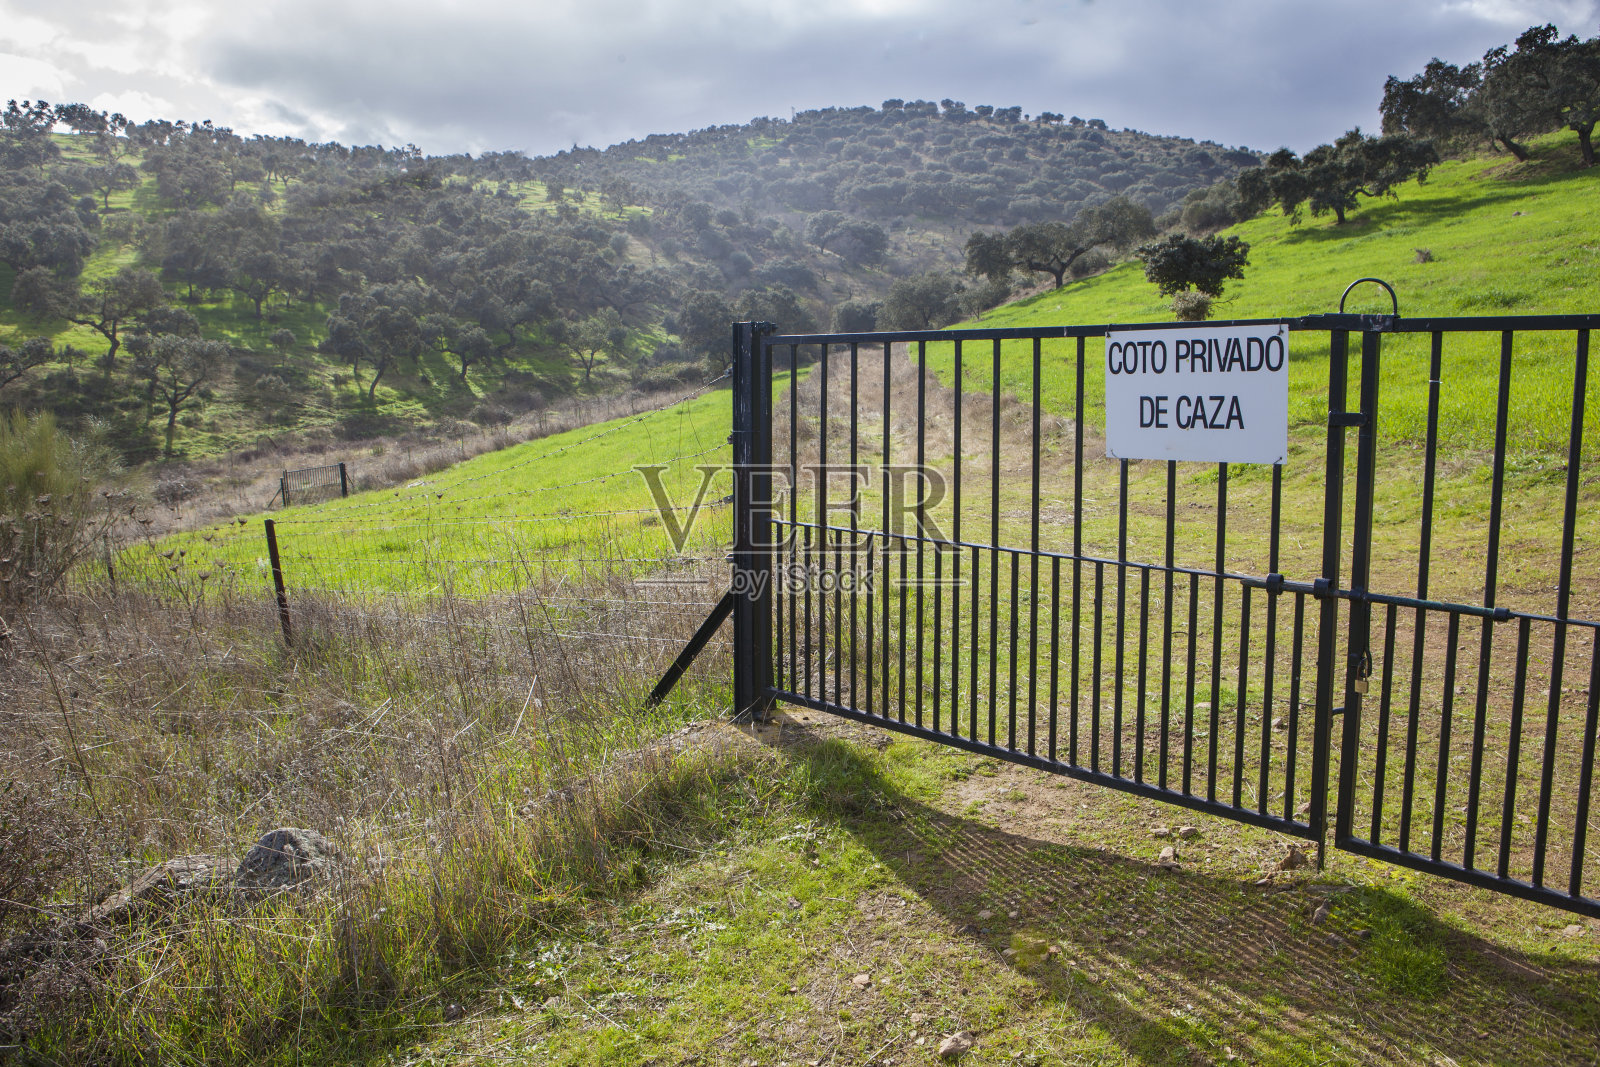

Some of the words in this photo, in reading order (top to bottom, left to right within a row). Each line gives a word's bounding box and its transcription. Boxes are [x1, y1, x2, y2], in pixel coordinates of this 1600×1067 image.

[1108, 340, 1167, 375] COTO
[1175, 335, 1285, 373] PRIVADO
[1139, 395, 1169, 429] DE
[1175, 395, 1245, 430] CAZA
